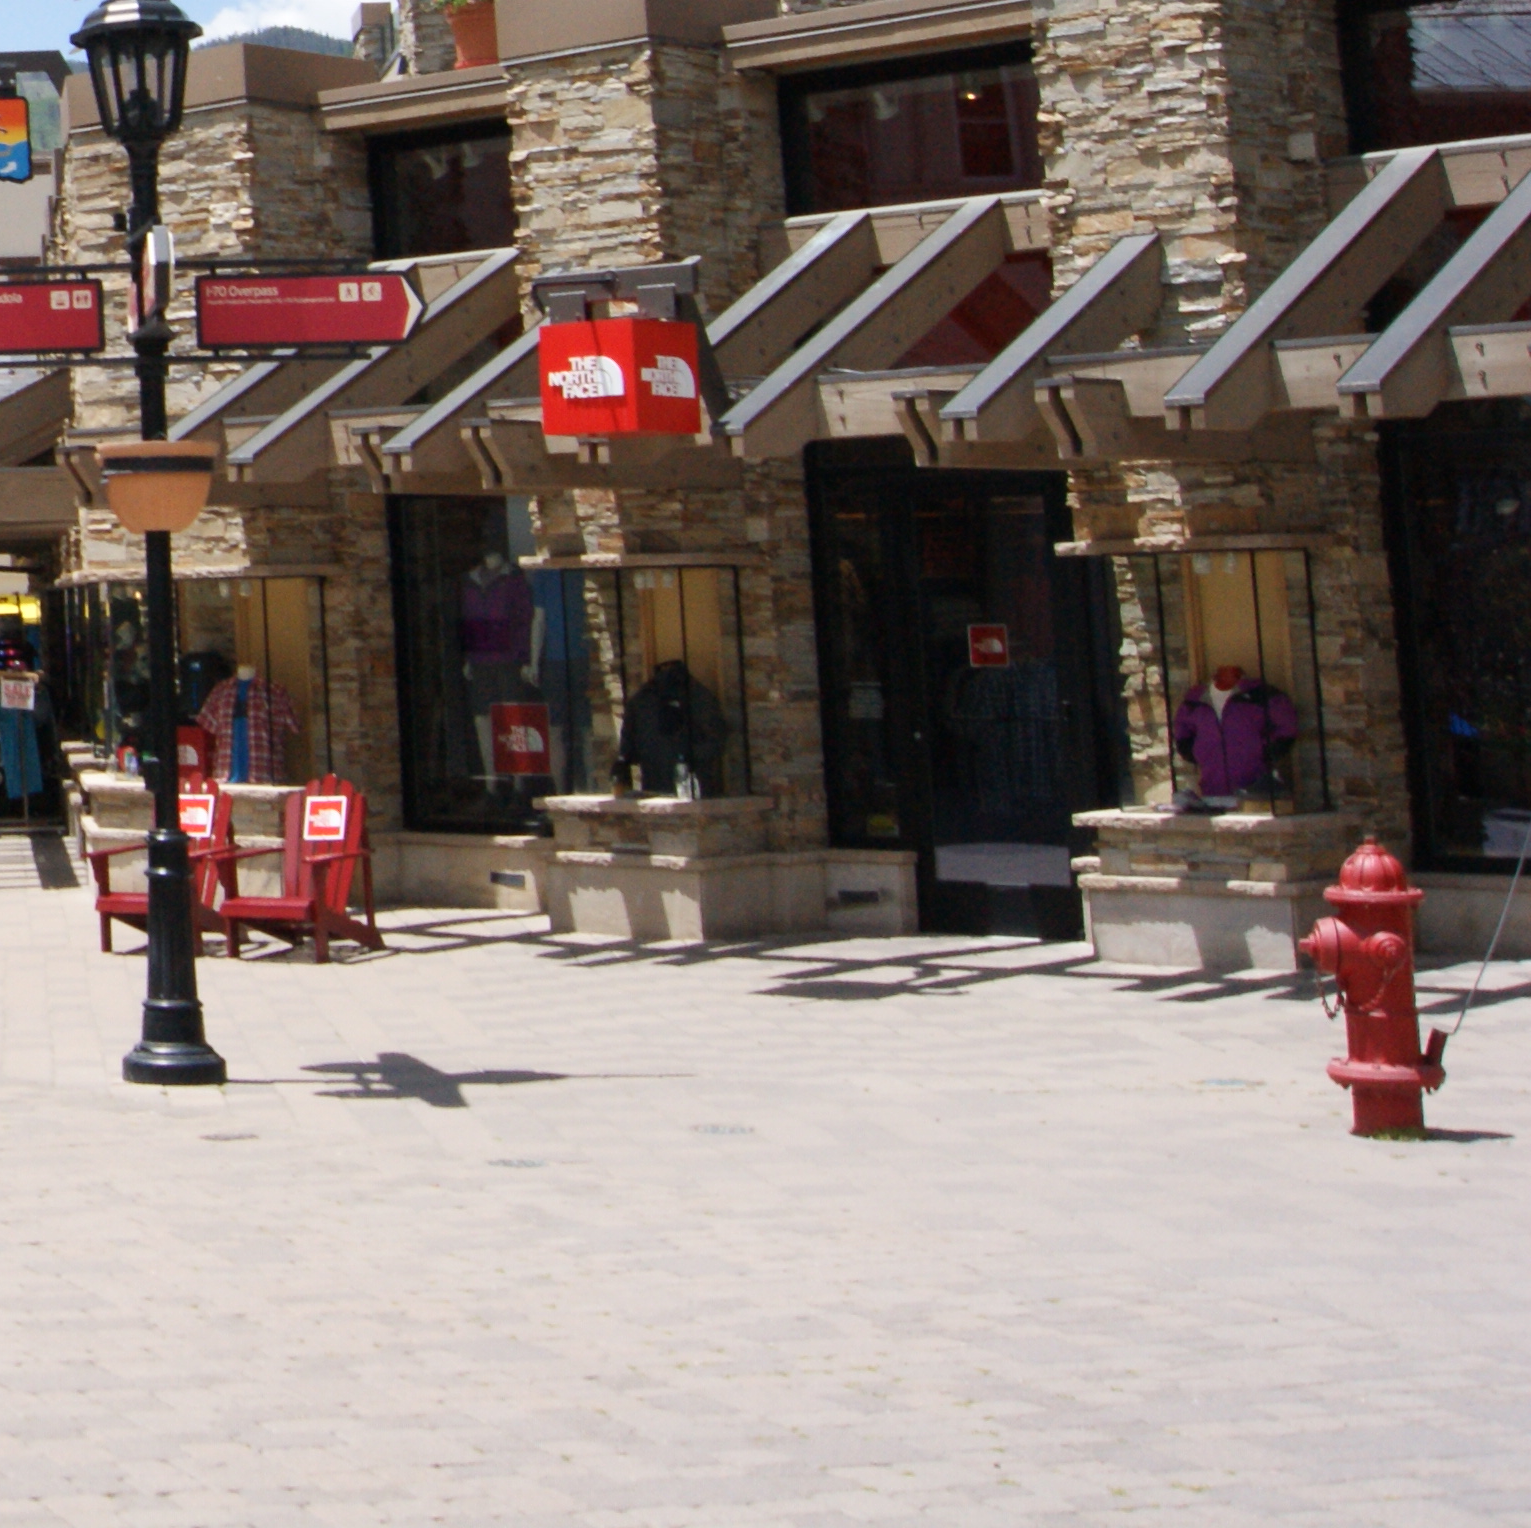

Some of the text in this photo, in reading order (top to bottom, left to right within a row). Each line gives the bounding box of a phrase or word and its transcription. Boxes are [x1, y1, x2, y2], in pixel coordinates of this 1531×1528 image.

[206, 285, 279, 299] I-70 Overpass
[568, 356, 598, 371] THE
[548, 370, 598, 386] NORTH
[563, 383, 599, 398] FACE
